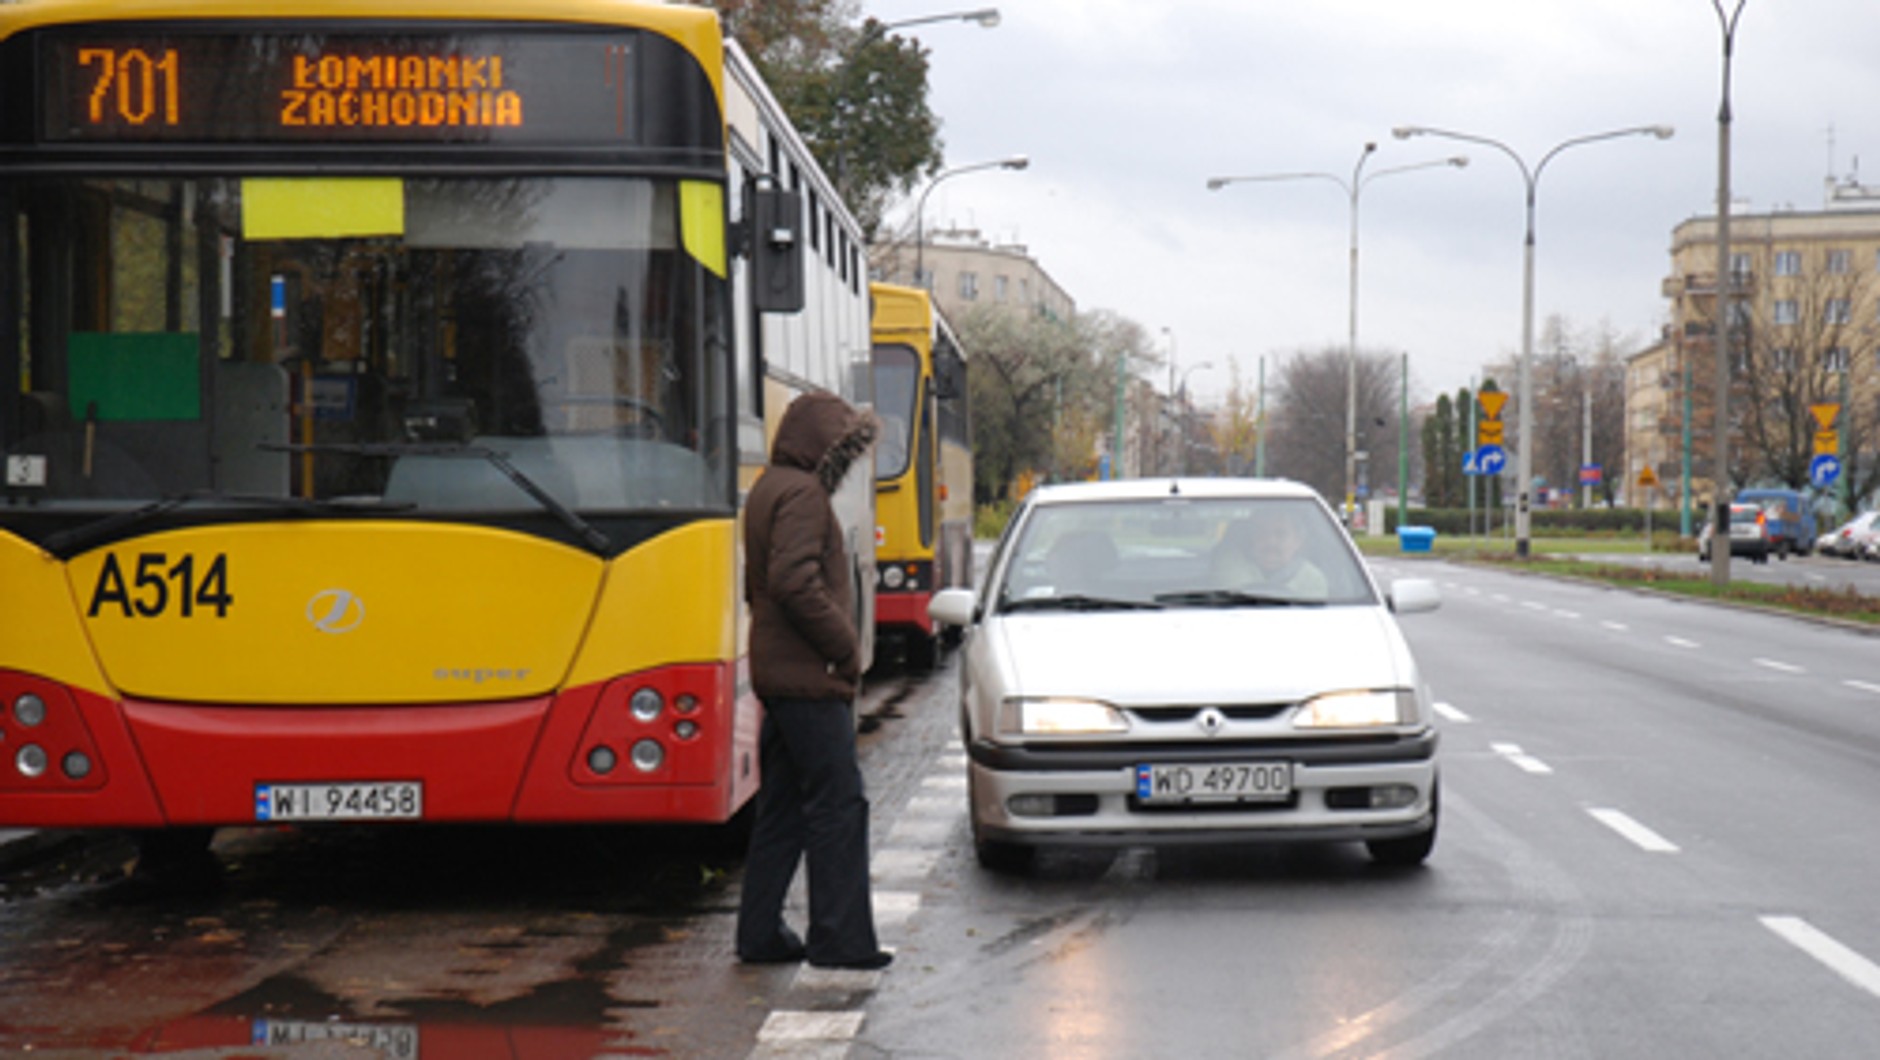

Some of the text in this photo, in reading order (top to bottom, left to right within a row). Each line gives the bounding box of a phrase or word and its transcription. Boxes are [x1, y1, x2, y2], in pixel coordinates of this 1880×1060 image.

[78, 48, 180, 127] 701
[292, 55, 503, 90] ŁOMIANKI
[280, 90, 523, 127] ZACHODNIA
[87, 553, 233, 618] A514
[1154, 769, 1193, 794] WD
[1203, 767, 1285, 791] 49700
[274, 787, 311, 815] WI
[326, 785, 416, 815] 94458
